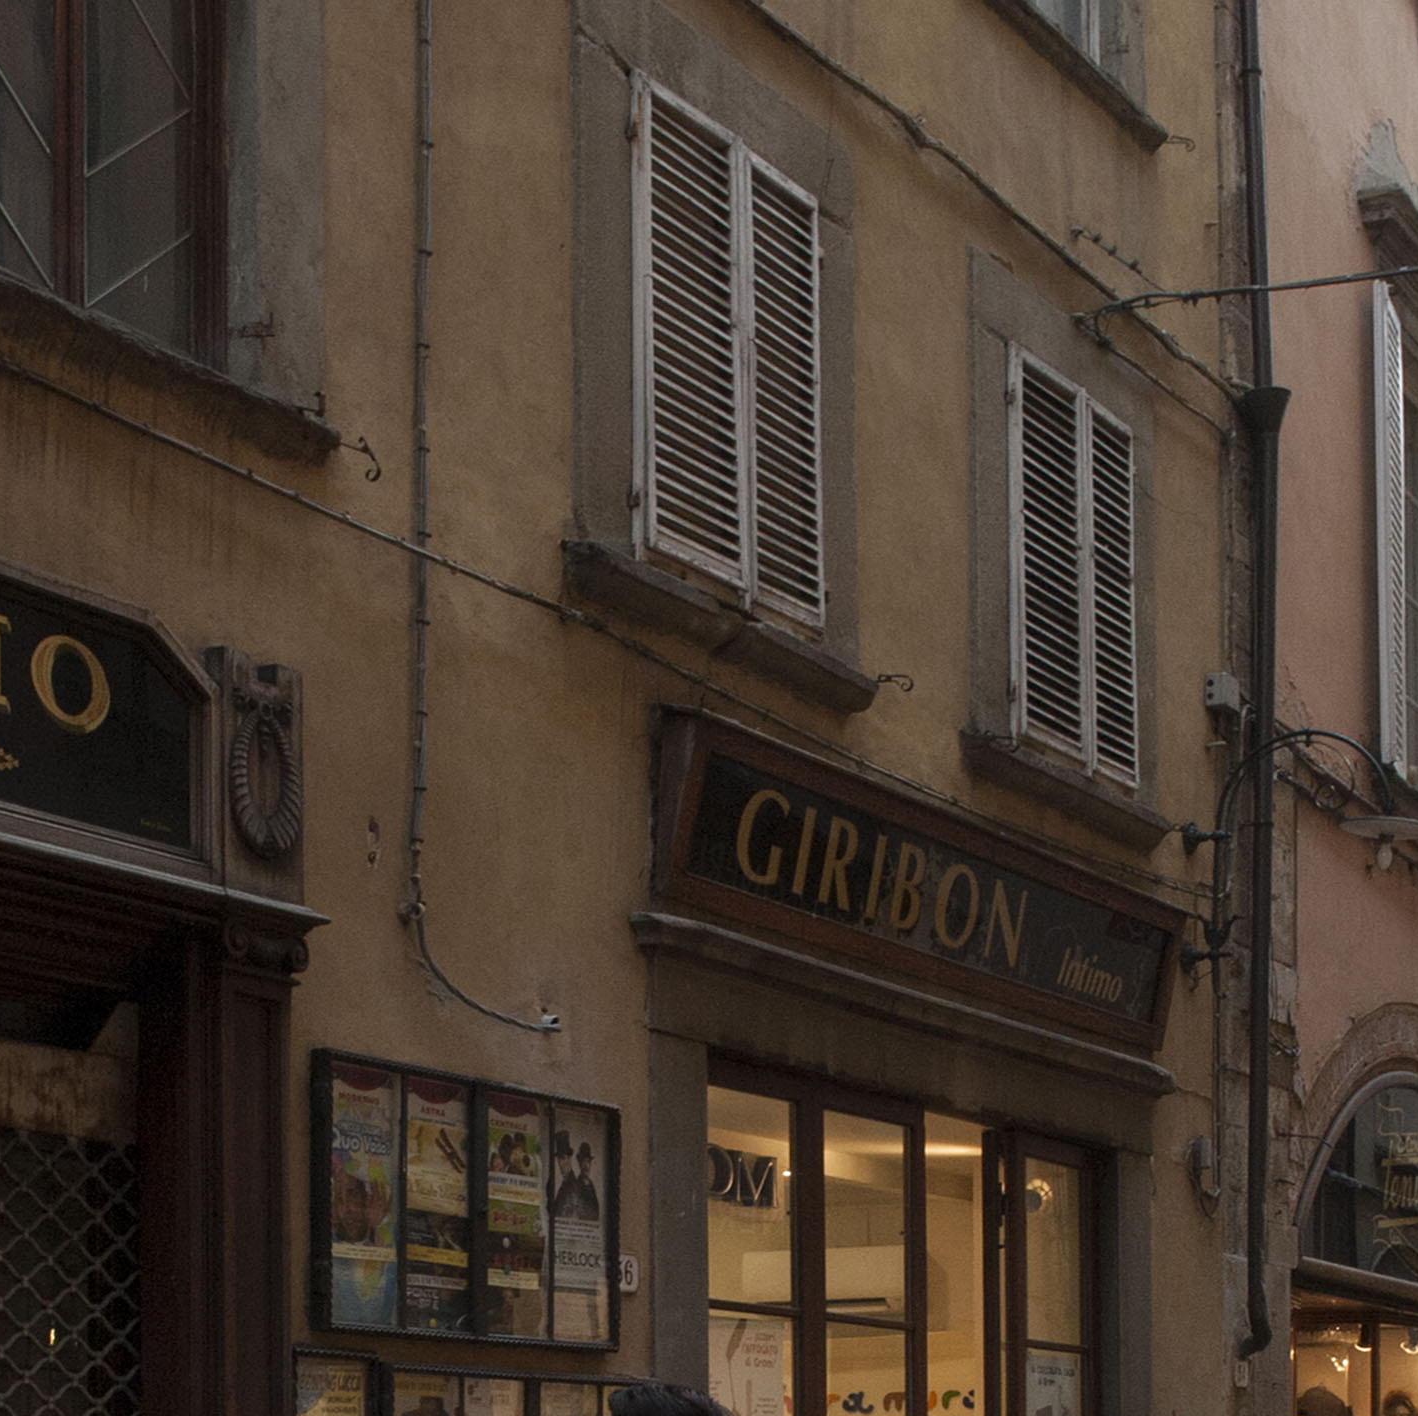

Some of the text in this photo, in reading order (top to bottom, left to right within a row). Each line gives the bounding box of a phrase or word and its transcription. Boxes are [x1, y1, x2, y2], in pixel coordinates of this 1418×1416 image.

[736, 788, 1029, 969] GIRIBON
[1057, 945, 1123, 1003] Intimo
[420, 1105, 446, 1117] ASTRA
